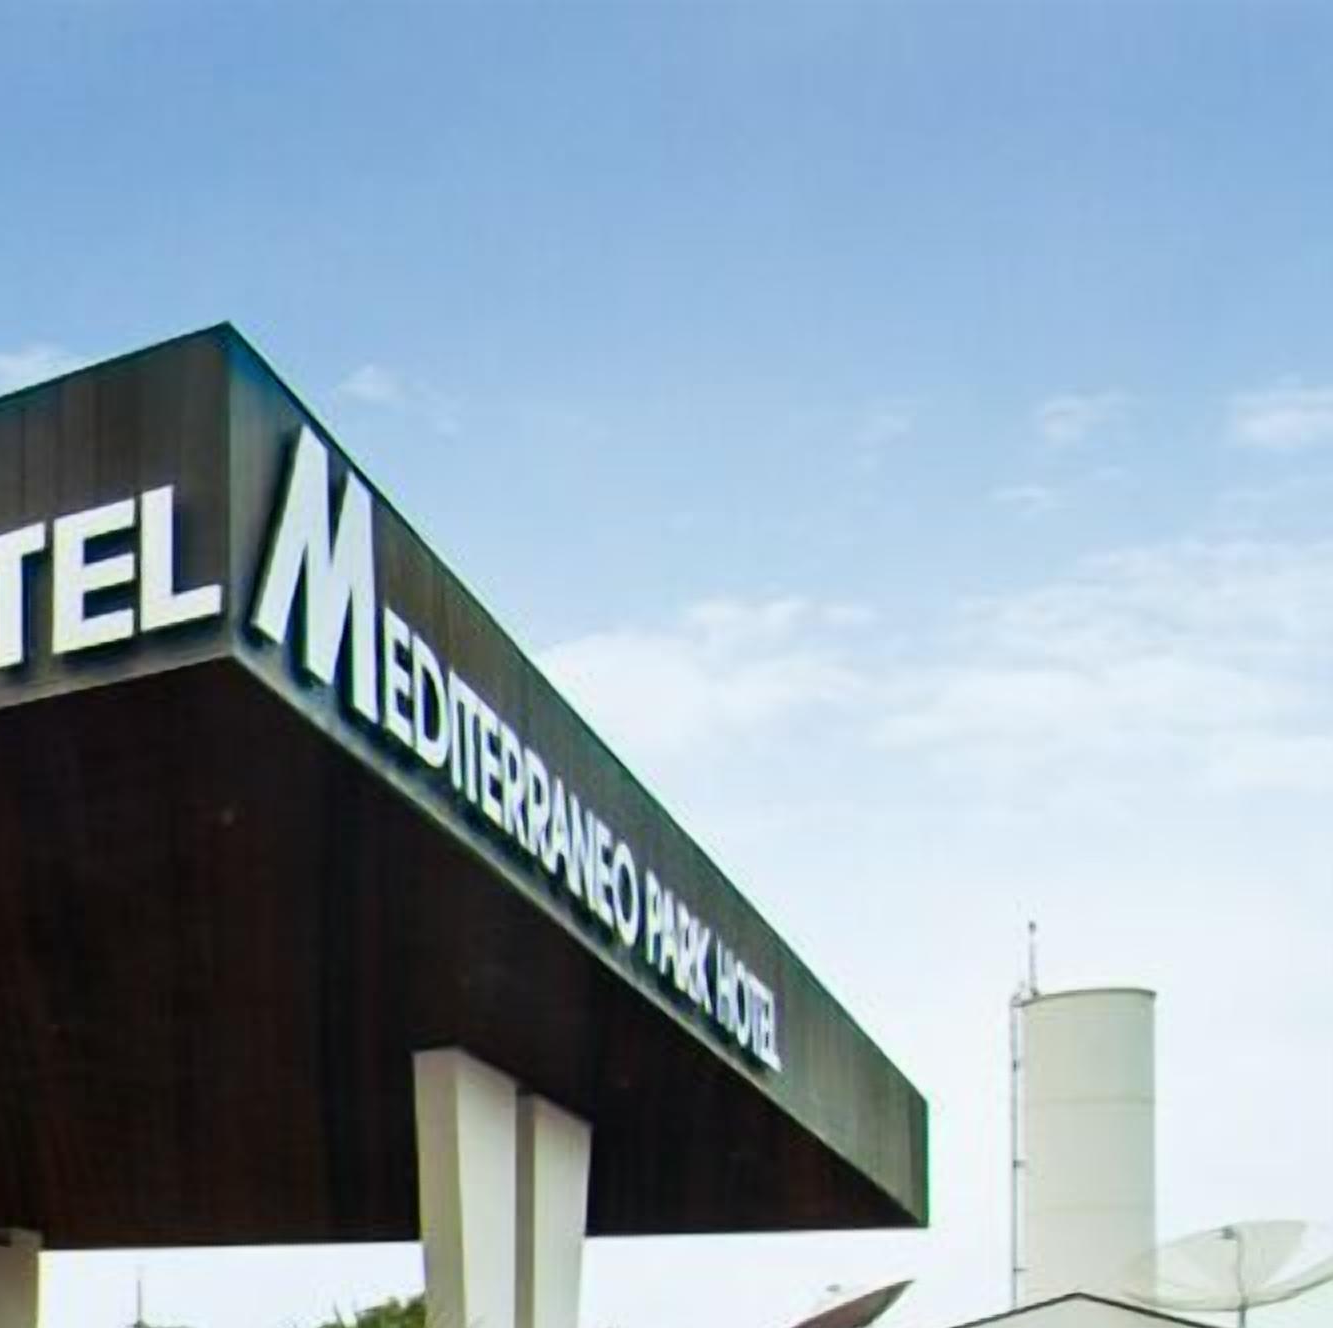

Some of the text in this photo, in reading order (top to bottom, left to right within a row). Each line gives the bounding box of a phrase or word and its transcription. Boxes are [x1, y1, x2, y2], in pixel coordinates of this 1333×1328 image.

[254, 426, 781, 1070] MEDITERRANEO PARK HOTEL
